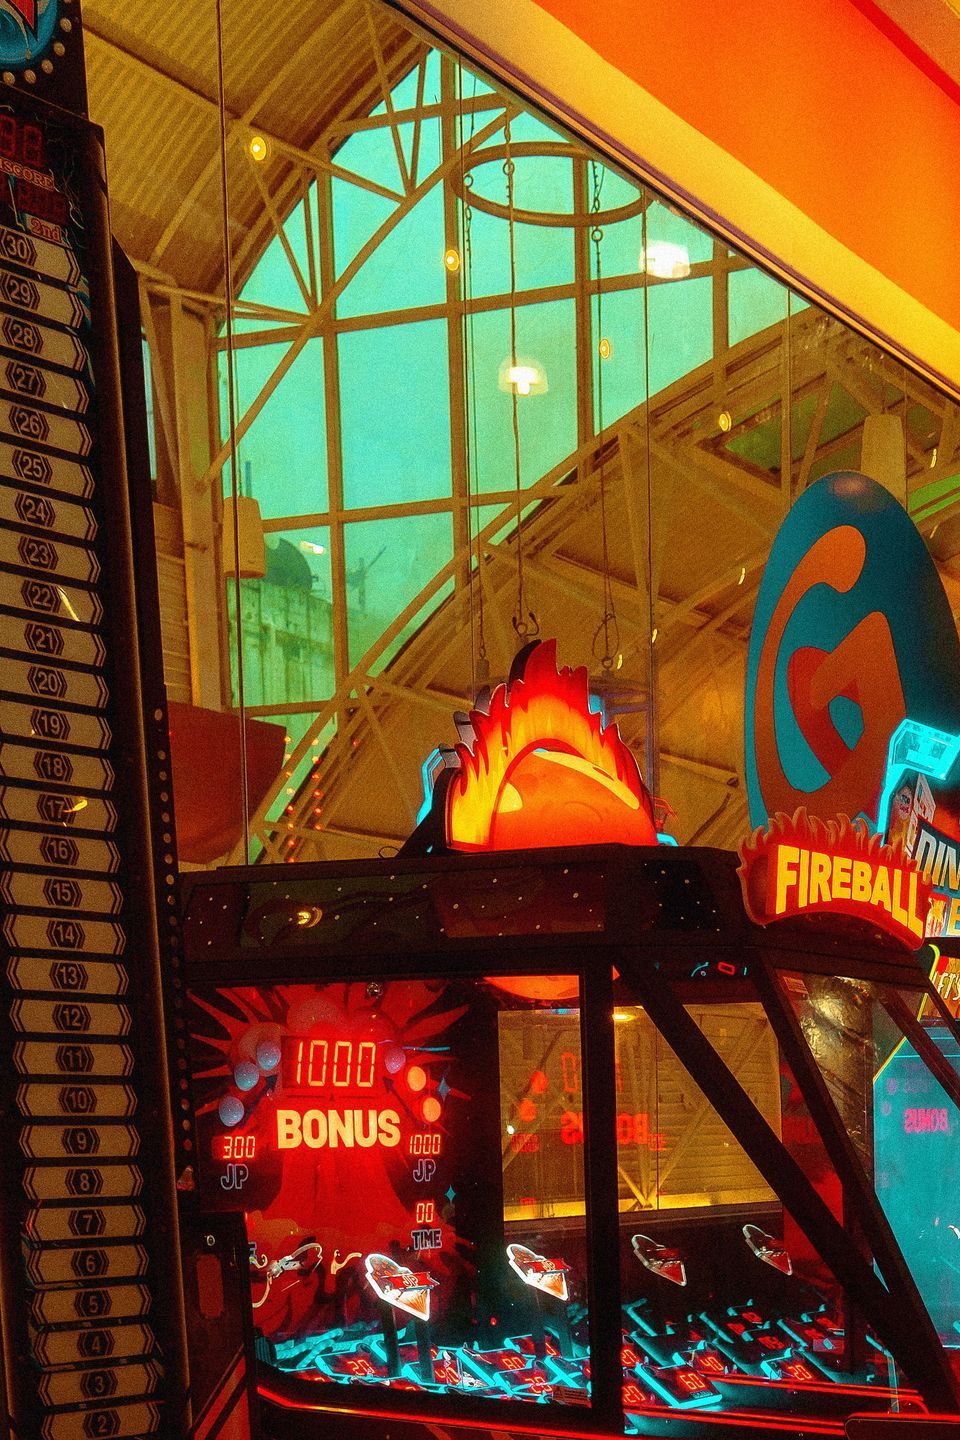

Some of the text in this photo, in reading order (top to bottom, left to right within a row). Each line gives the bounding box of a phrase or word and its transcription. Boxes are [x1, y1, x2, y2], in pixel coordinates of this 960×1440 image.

[0, 158, 54, 190] SCORE
[30, 218, 61, 241] 2nd
[6, 234, 28, 253] 30
[10, 281, 31, 302] 29
[12, 327, 34, 348] 28
[16, 370, 35, 389] 27
[19, 412, 40, 433] 26
[22, 455, 43, 477] 25
[25, 499, 46, 521] 24
[28, 543, 49, 564] 23
[31, 586, 51, 606] 22
[35, 629, 54, 649] 21
[37, 671, 58, 692] 20
[40, 715, 60, 735] 19
[44, 757, 63, 777] 18
[48, 800, 65, 818] 17
[50, 839, 68, 859] 16
[53, 882, 70, 901] 15
[775, 844, 925, 939] FIREBALL
[57, 926, 75, 945] 14
[60, 967, 78, 985] 13
[63, 1009, 80, 1028] 12
[66, 1050, 84, 1068] 11
[296, 1039, 376, 1088] 1000
[69, 1091, 88, 1110] 10
[276, 1109, 401, 1149] BONUS
[76, 1131, 88, 1150] 9
[222, 1135, 255, 1159] 300
[409, 1133, 441, 1155] 1000
[220, 1163, 249, 1190] JP
[412, 1158, 436, 1182] JP
[79, 1172, 90, 1192] 8
[82, 1214, 93, 1233] 7
[411, 1229, 442, 1250] TIME
[86, 1255, 96, 1273] 6
[402, 1273, 419, 1287] JP
[88, 1295, 99, 1315] 5
[91, 1336, 101, 1353] 4
[680, 1372, 707, 1391] 60
[789, 1364, 813, 1382] 20
[95, 1375, 105, 1394] 3
[97, 1416, 108, 1433] 2
